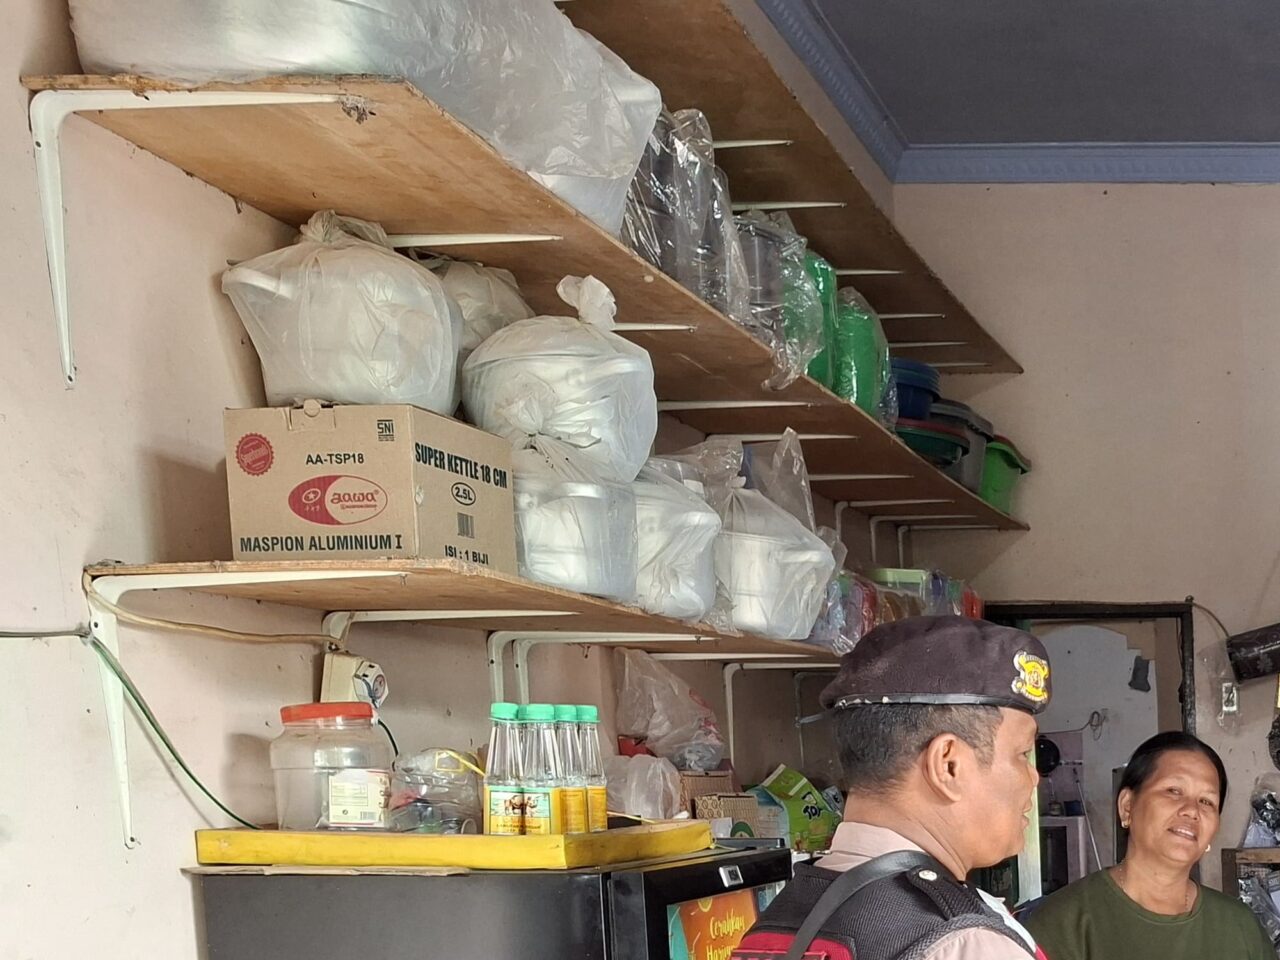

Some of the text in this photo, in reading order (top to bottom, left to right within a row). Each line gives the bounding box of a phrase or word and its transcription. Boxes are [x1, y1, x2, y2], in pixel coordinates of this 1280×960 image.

[377, 422, 395, 434] SNI
[306, 453, 365, 465] AA-TSP18
[415, 442, 507, 488] SUPER KETTLE 18 CM
[454, 486, 473, 502] 2.5L
[240, 536, 305, 553] MASPION
[308, 534, 392, 551] ALUMINIUM
[445, 544, 457, 558] ISI
[464, 550, 469, 561] 1
[472, 551, 489, 565] BIJI
